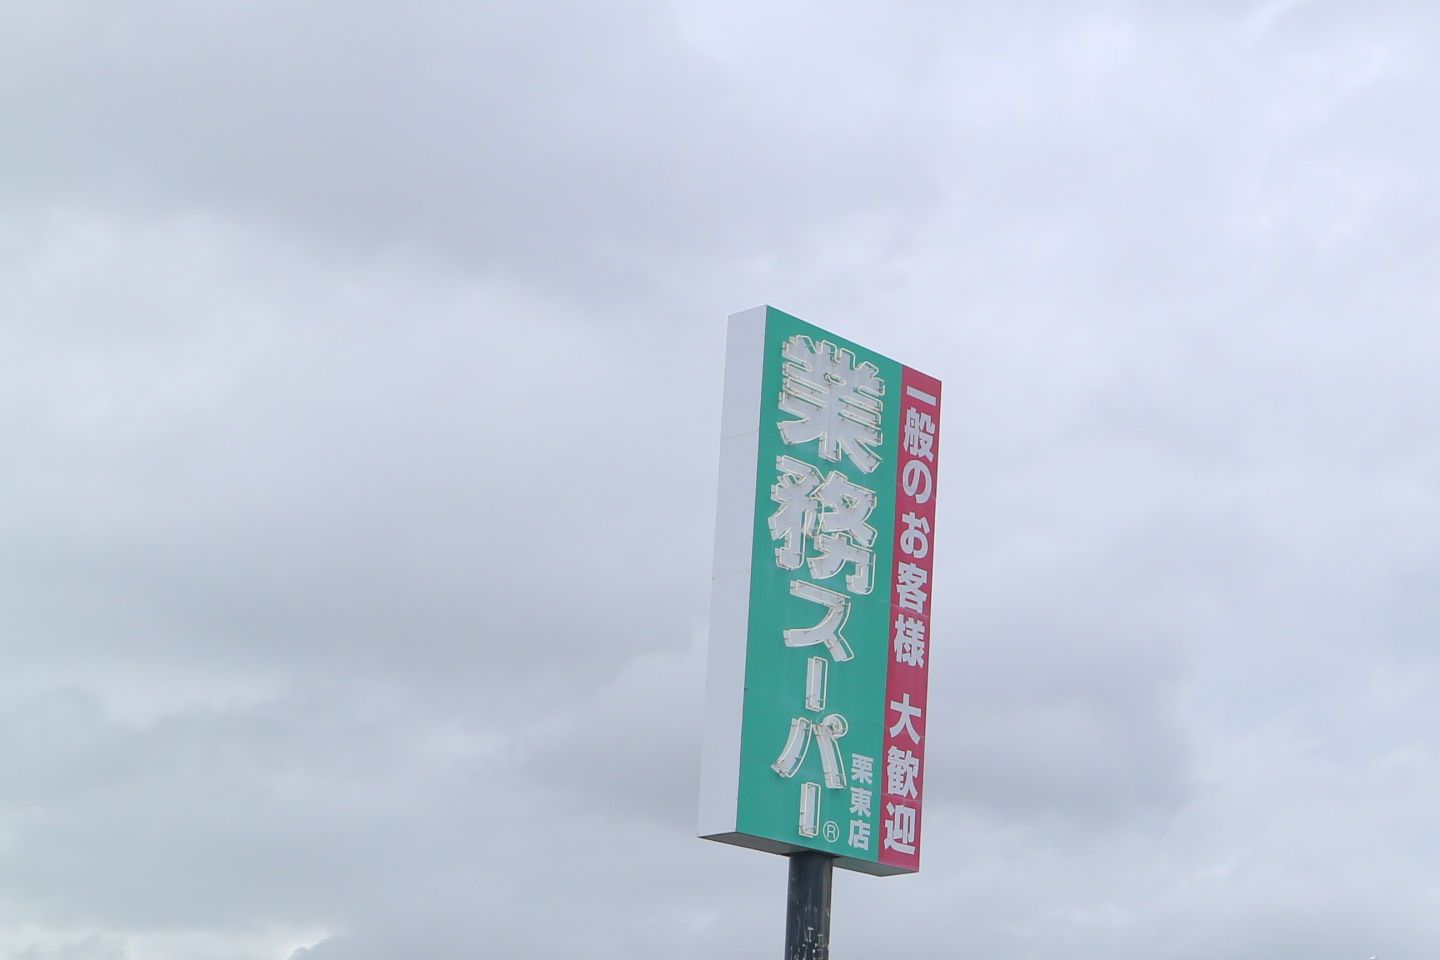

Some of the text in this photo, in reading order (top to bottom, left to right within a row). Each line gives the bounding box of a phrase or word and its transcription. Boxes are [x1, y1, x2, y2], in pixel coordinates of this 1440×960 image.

[766, 334, 886, 838] 業務スーパー
[848, 752, 875, 852] 栗東店
